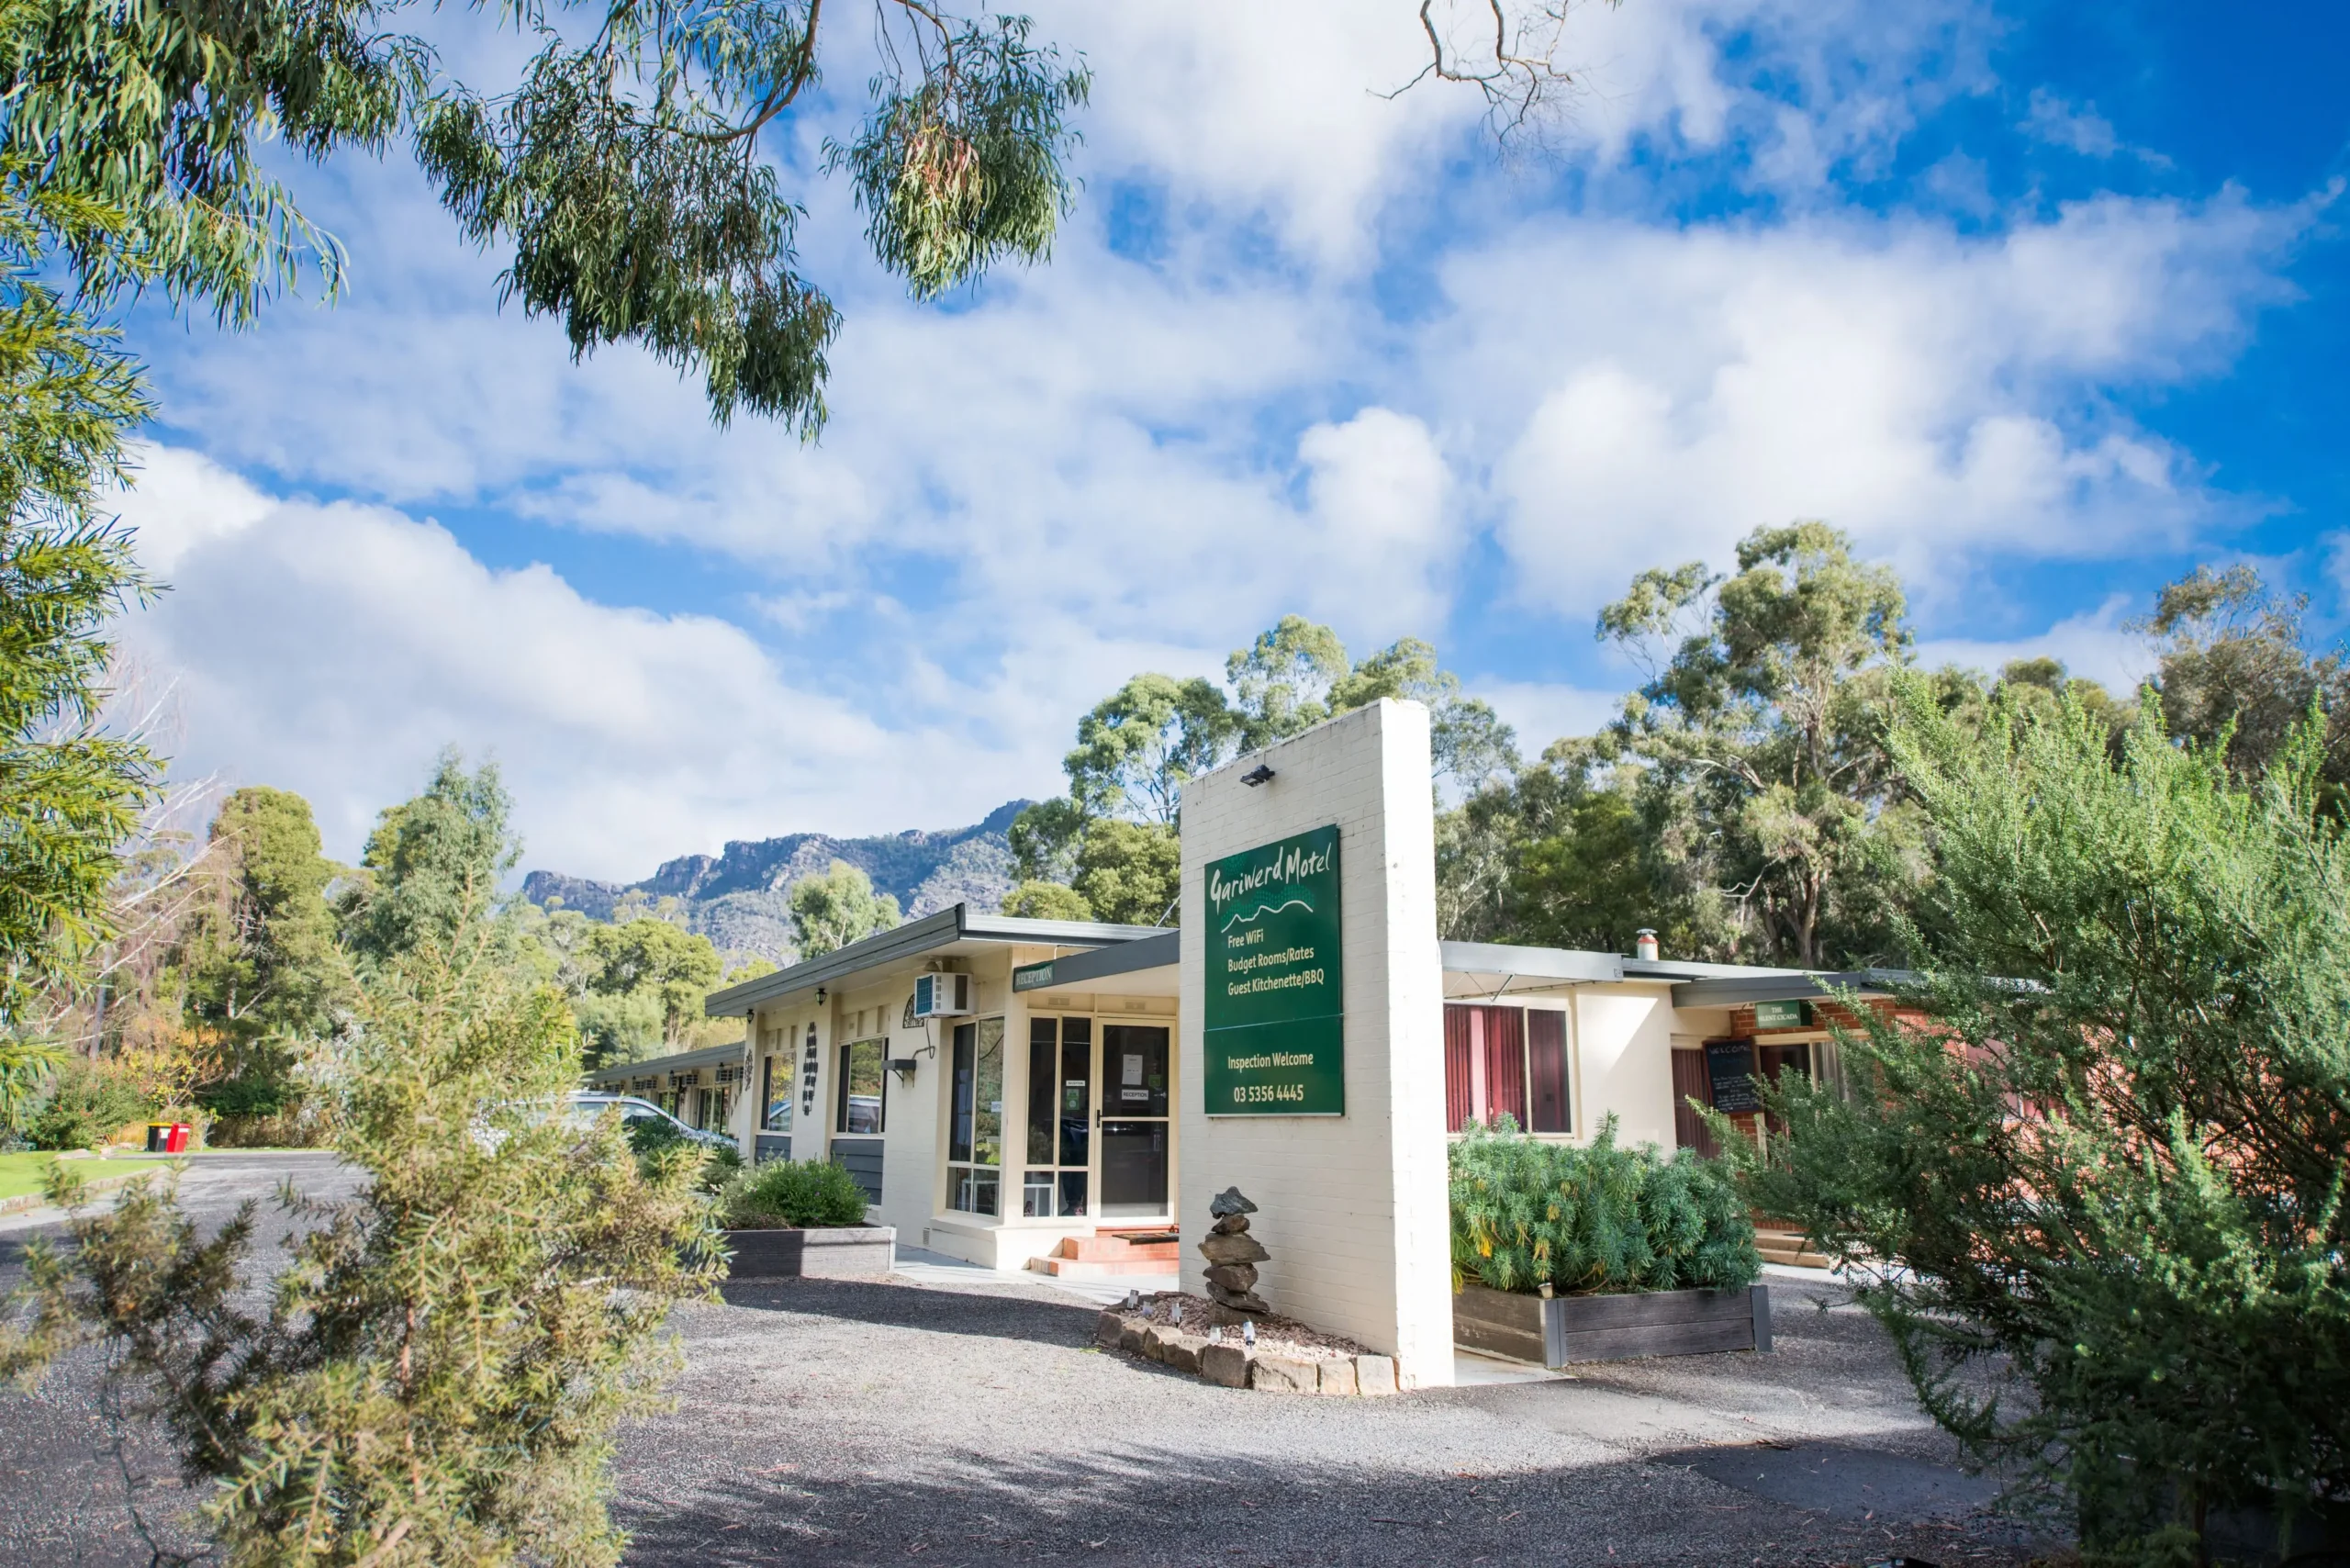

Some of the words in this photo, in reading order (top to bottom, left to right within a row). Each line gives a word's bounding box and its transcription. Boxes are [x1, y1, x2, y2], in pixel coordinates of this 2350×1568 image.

[1211, 846, 1283, 915] Gariwerd
[1286, 842, 1331, 884] Motel
[1228, 935, 1245, 948] Free
[1246, 928, 1263, 945] WiFi
[1228, 956, 1257, 974] Budget
[1258, 946, 1315, 968] Rooms/Rates
[1016, 967, 1052, 985] RECEPTION
[1228, 980, 1251, 996] Guest
[1252, 968, 1325, 989] Kitchenette/BBQ
[1228, 1054, 1270, 1073] Inspection
[1272, 1051, 1314, 1067] Welcome
[1234, 1086, 1247, 1103] 03
[1248, 1085, 1274, 1103] 5356
[1276, 1083, 1304, 1102] 4445
